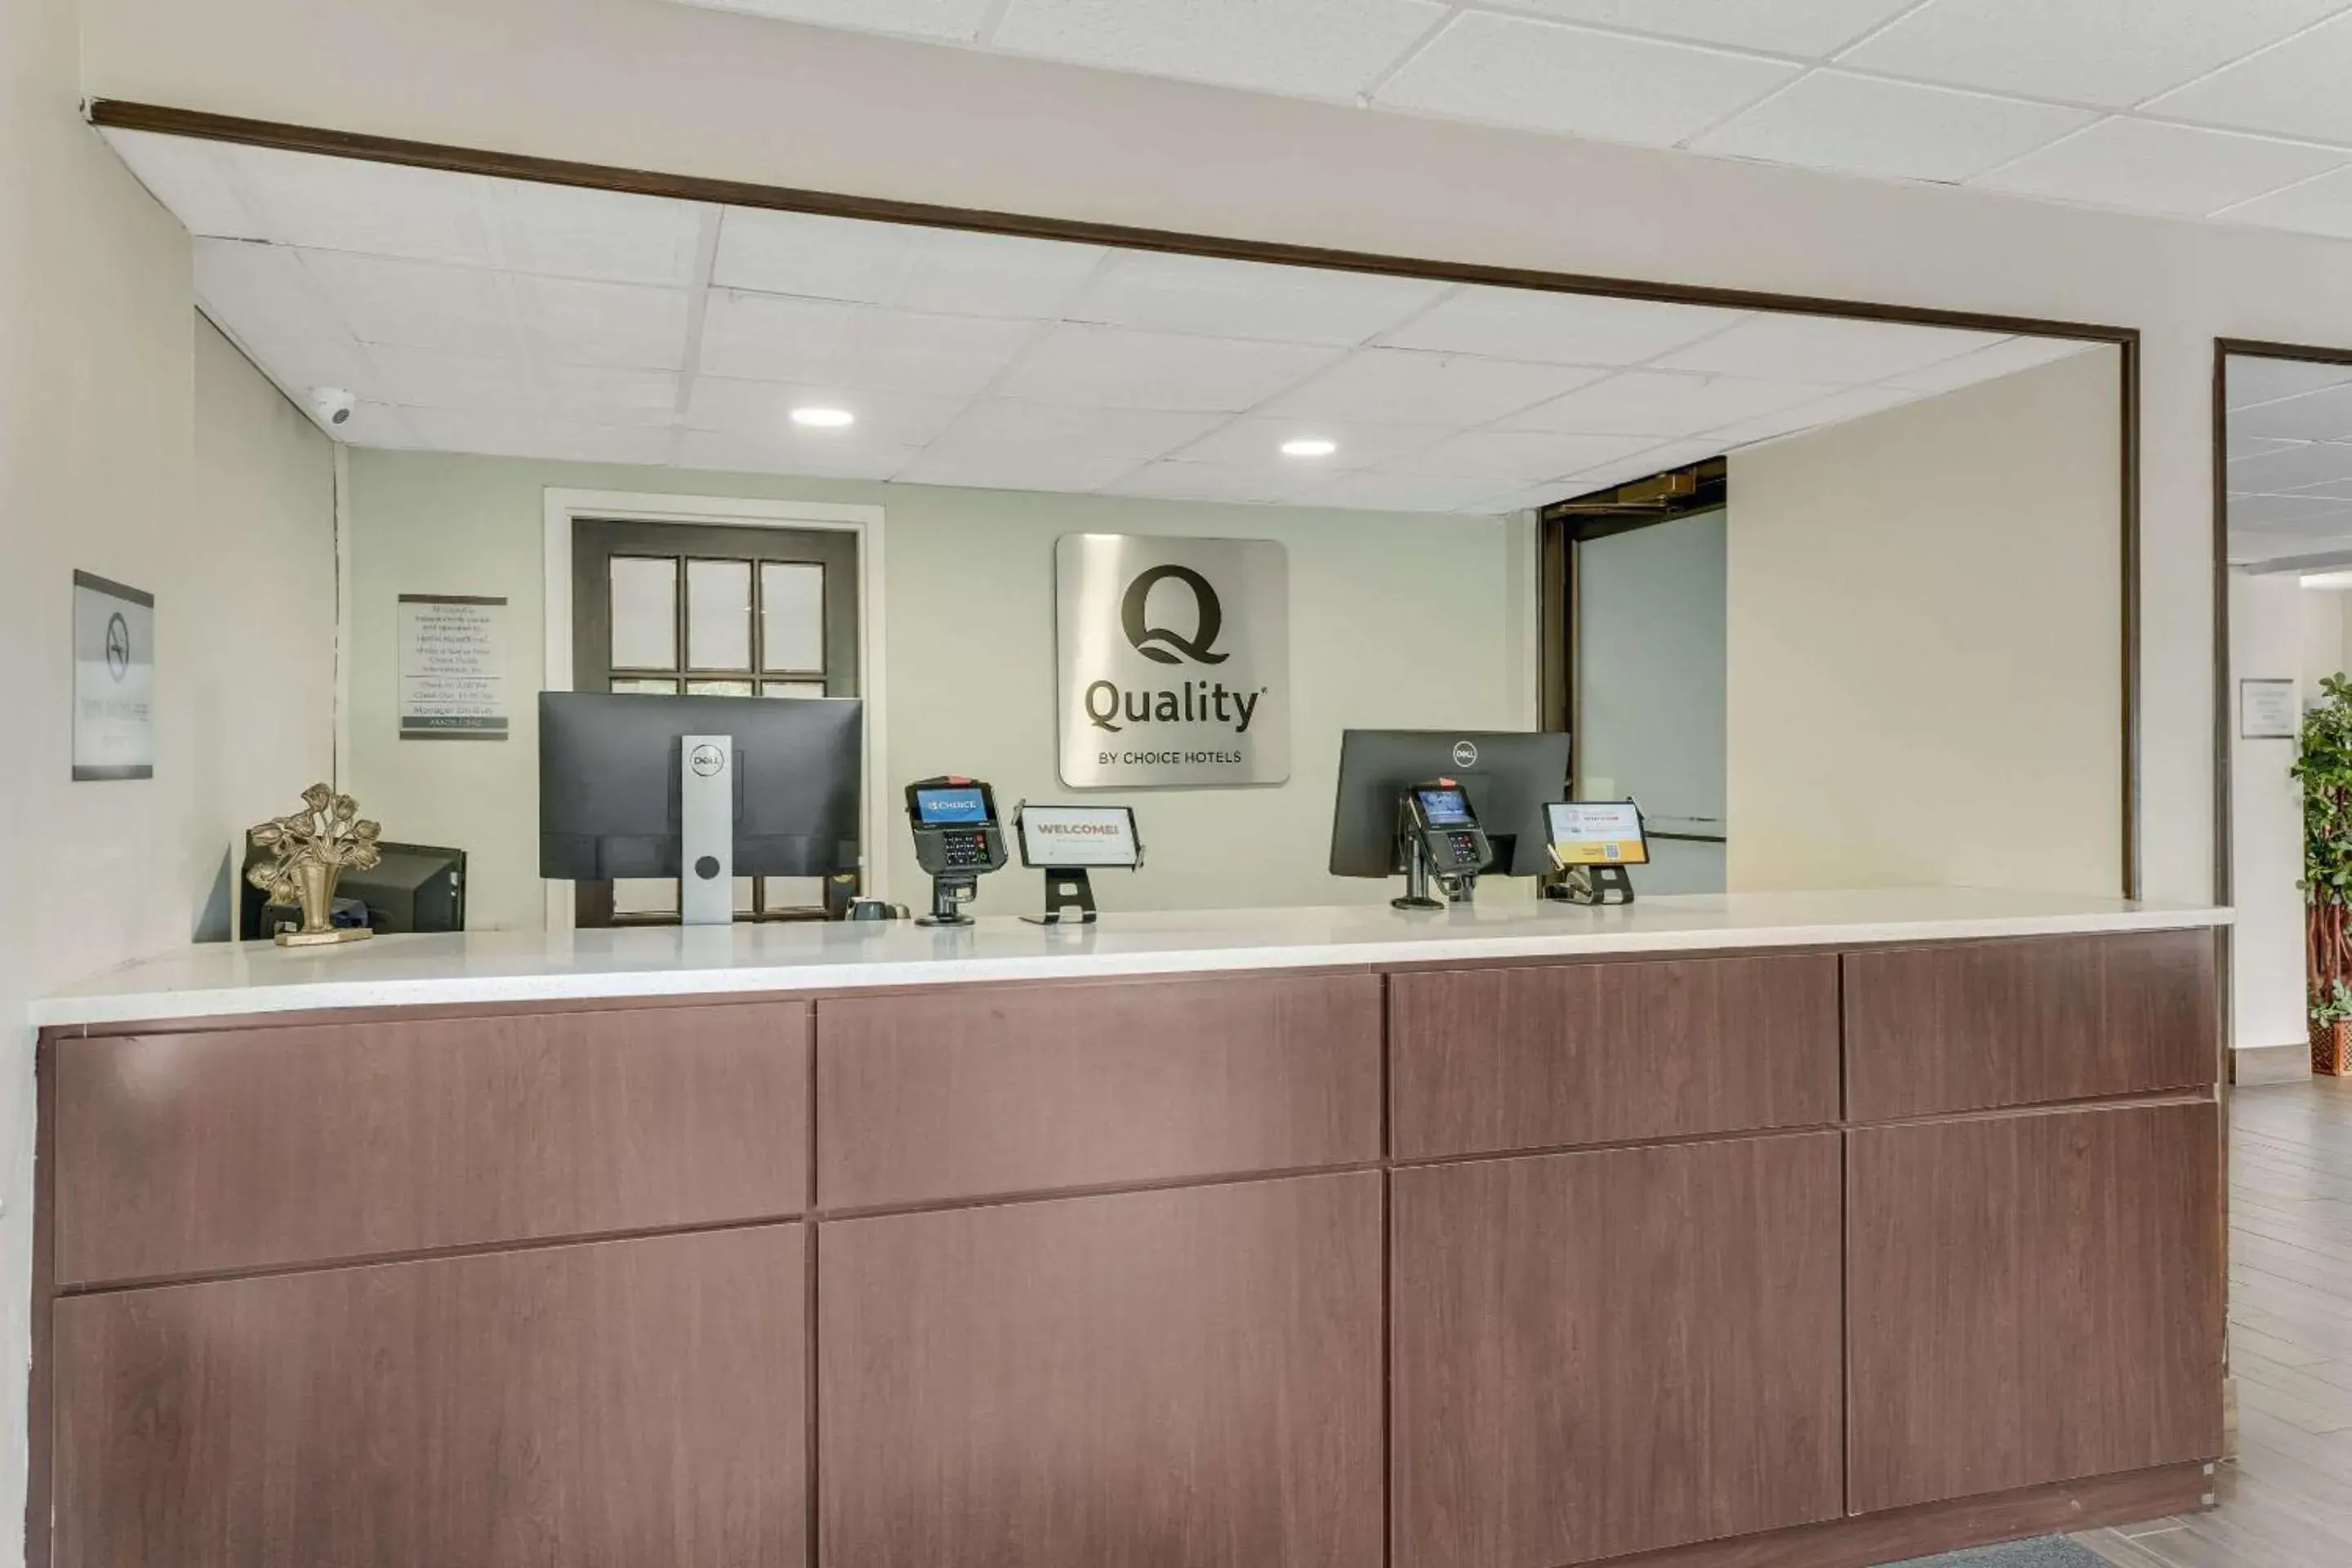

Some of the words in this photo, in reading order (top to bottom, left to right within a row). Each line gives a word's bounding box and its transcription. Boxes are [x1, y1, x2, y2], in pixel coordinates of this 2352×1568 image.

[1120, 564, 1230, 665] Q
[1084, 679, 1259, 733] Quality
[694, 756, 718, 764] DELL
[1098, 751, 1118, 764] BY
[1123, 751, 1180, 764] CHOICE
[1184, 751, 1241, 764] HOTELS
[1456, 750, 1474, 758] DELL
